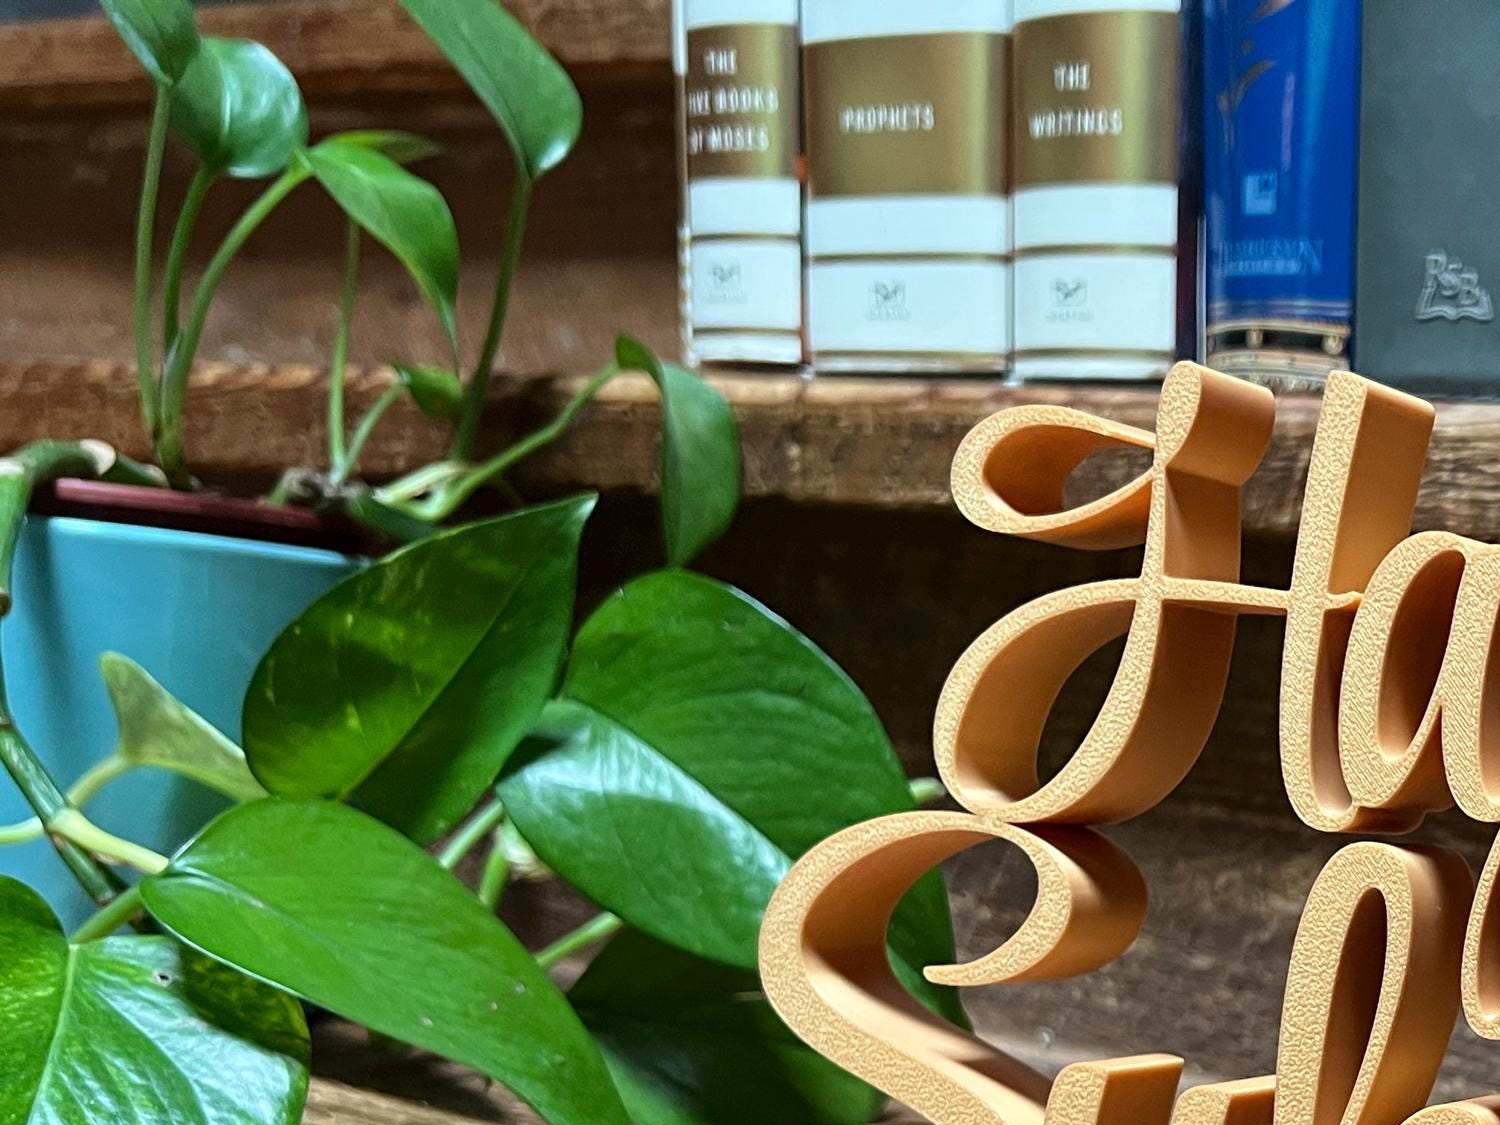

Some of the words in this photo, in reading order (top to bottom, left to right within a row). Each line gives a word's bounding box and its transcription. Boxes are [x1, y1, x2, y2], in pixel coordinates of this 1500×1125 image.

[1054, 62, 1090, 91] THE
[714, 84, 778, 114] BOOKS
[840, 101, 934, 133] PROPHETS
[1029, 107, 1122, 139] WRITINGS
[707, 123, 769, 153] MOSES
